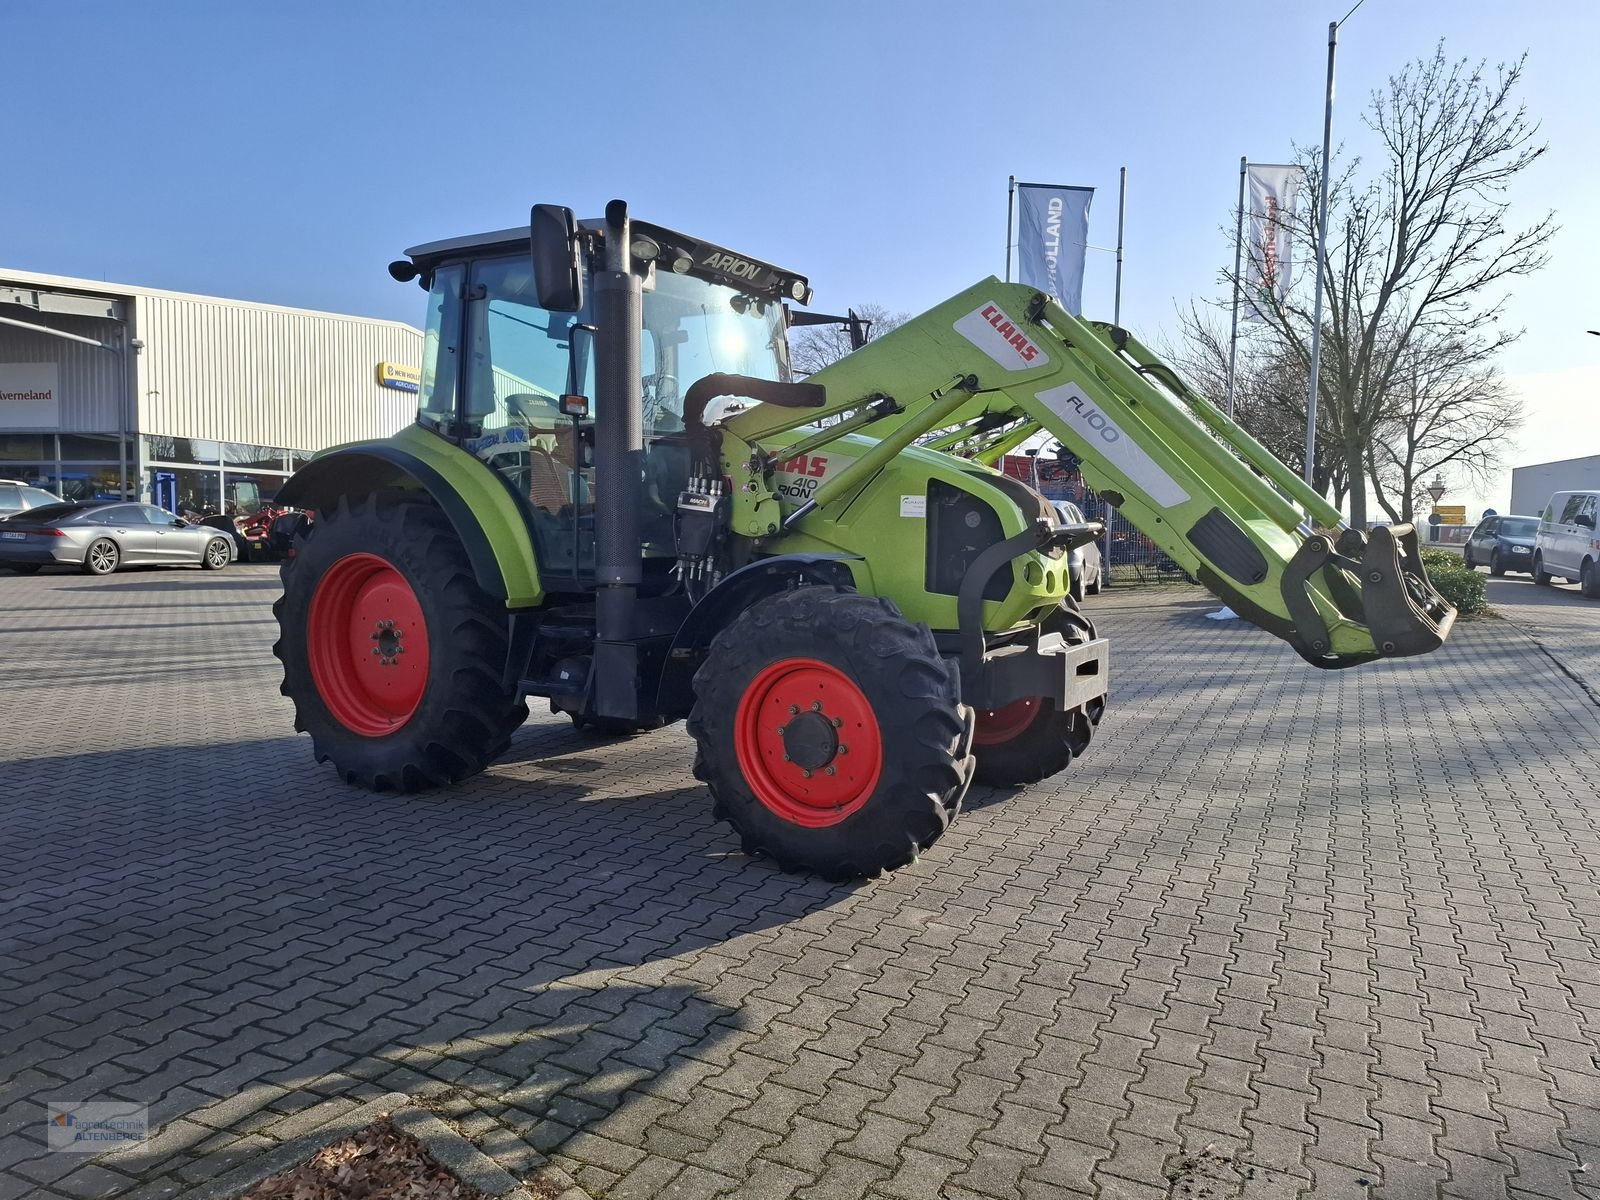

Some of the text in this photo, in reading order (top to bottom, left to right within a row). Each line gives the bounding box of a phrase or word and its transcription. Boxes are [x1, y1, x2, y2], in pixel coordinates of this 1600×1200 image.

[702, 252, 761, 280] ARION
[981, 305, 1039, 362] CLAAS
[793, 477, 818, 490] 410
